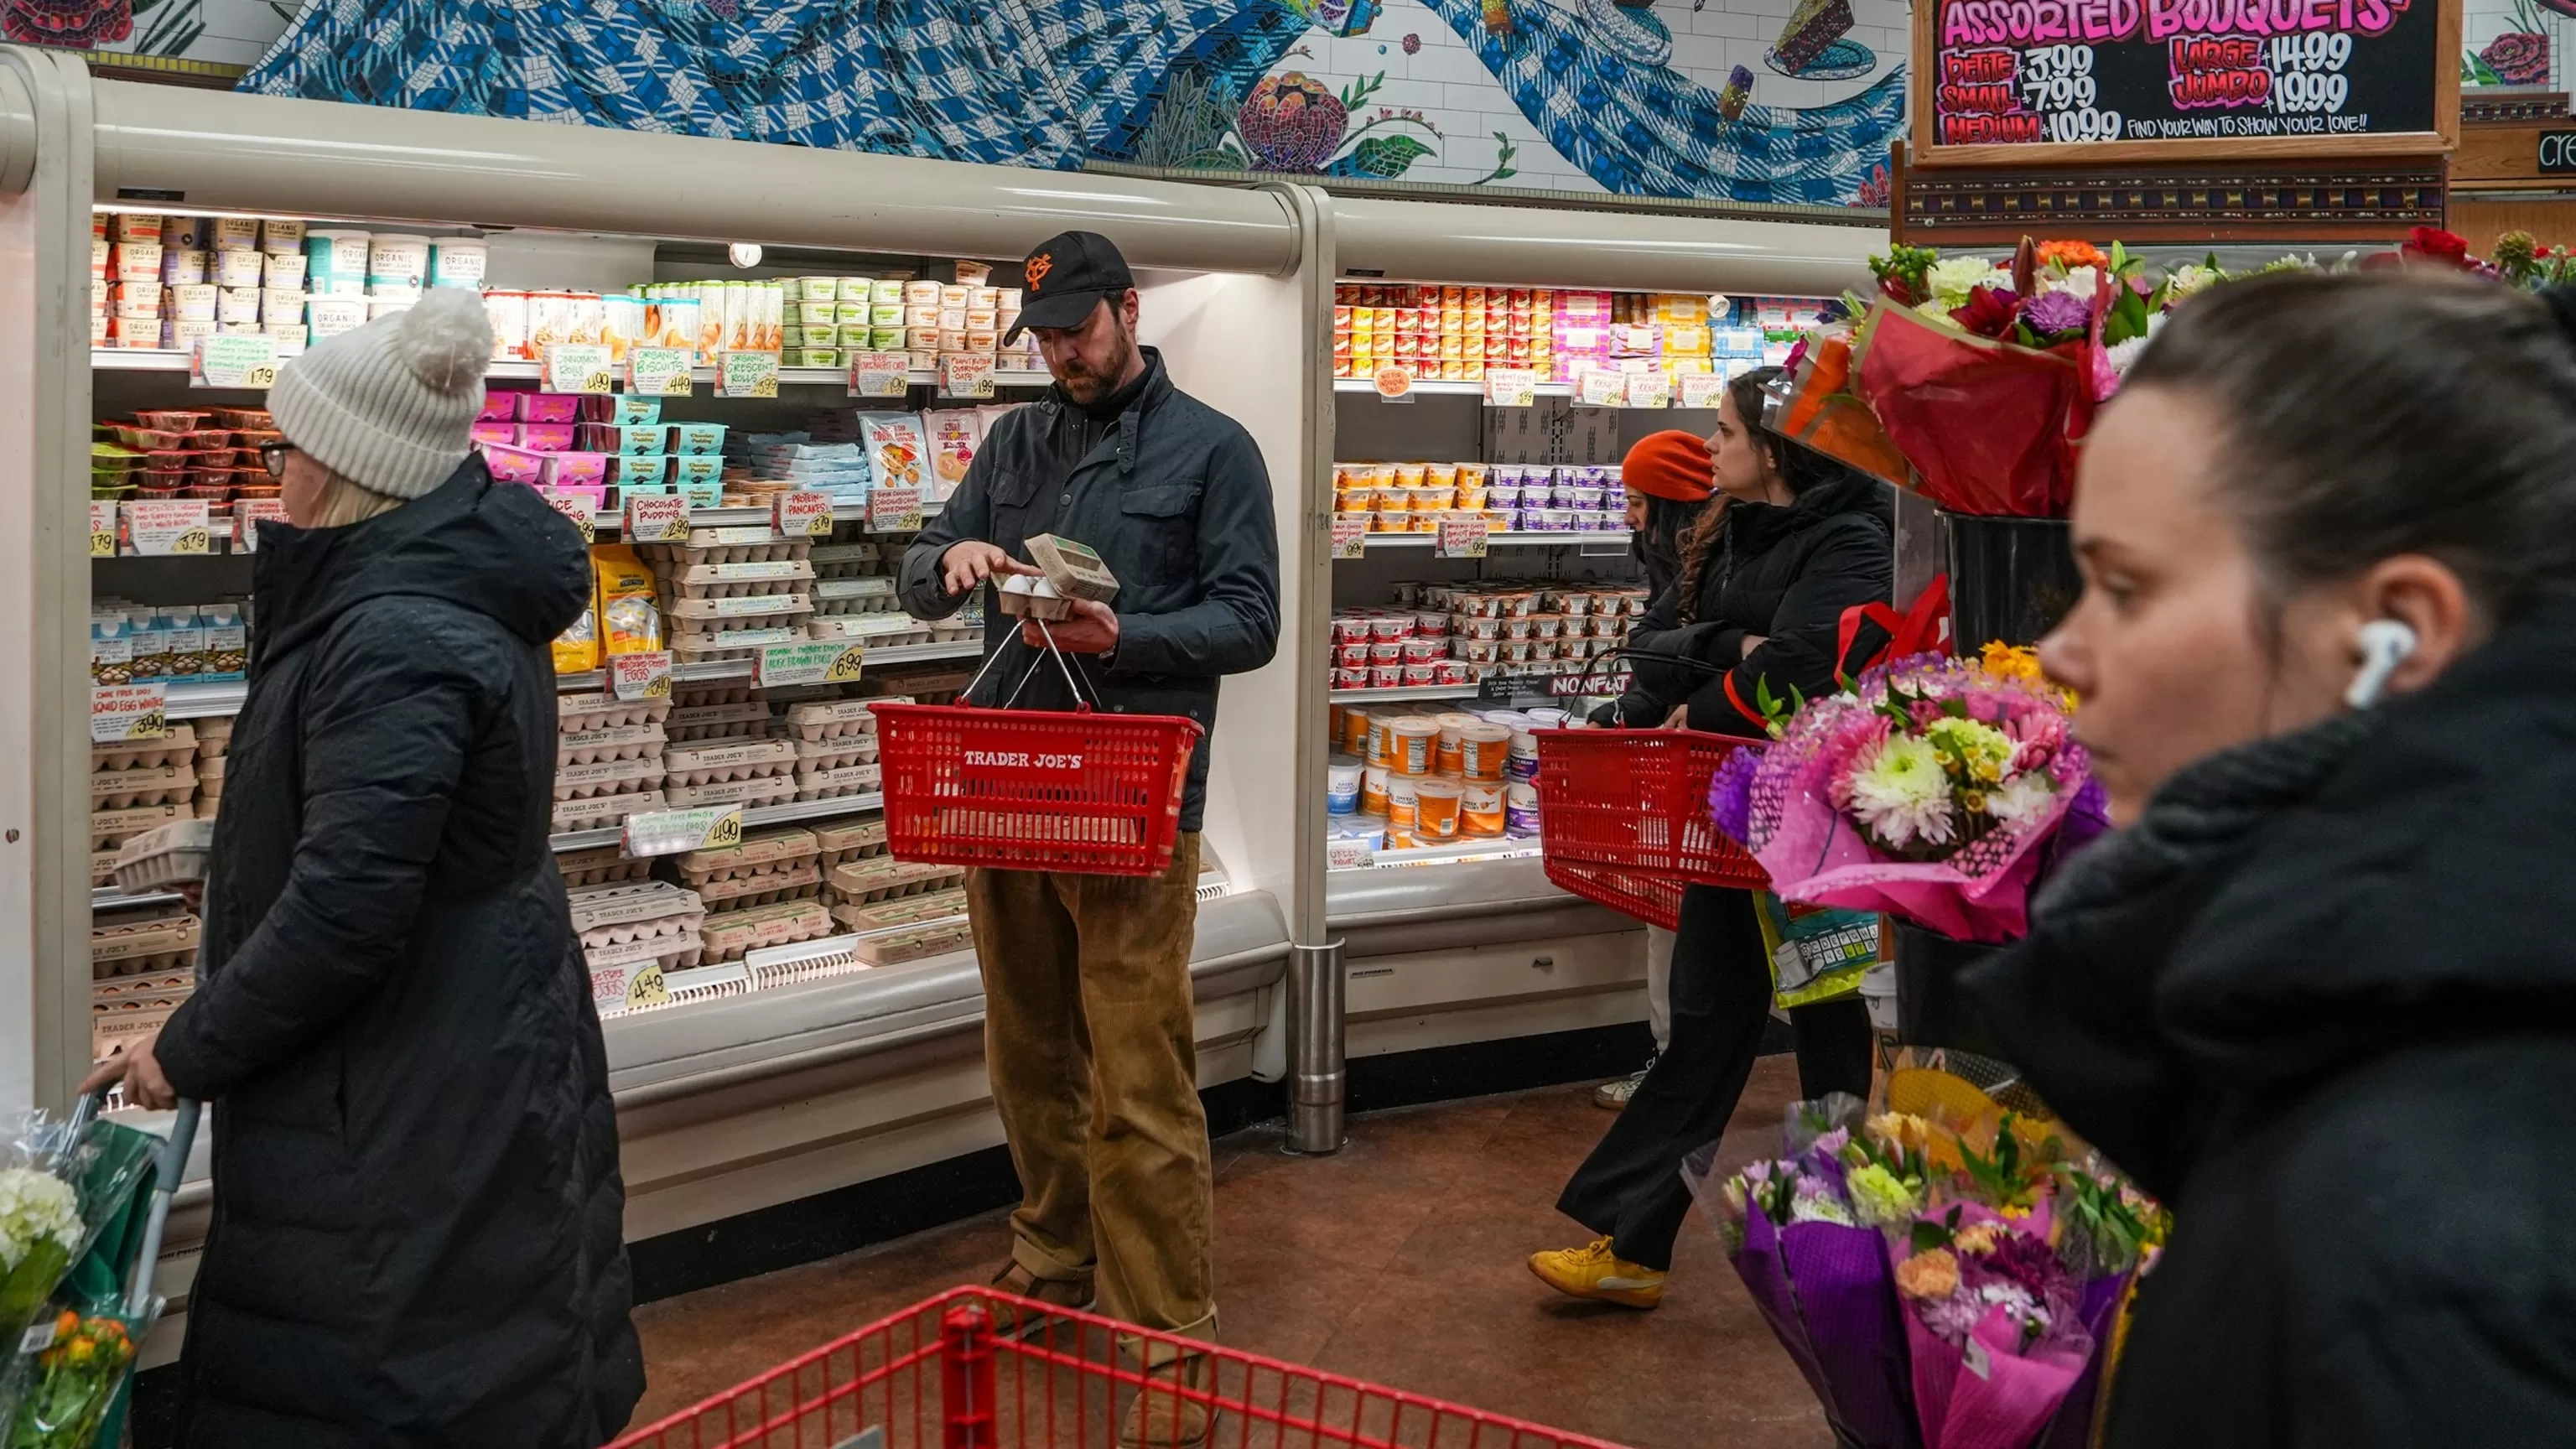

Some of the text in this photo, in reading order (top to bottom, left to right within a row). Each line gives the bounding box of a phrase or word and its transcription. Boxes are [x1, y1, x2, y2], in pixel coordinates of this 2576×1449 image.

[1944, 0, 2392, 46] ASSORTED BOUQUETS
[2172, 39, 2259, 73] LARGE
[1945, 52, 2014, 84] PETITE
[2174, 70, 2270, 102] JUMBO
[1941, 85, 2018, 113] SMALL
[1945, 114, 2040, 144] MEDIUM
[2127, 114, 2368, 140] FIND YOUR WAY TO SHOW YOUR LOVE!!
[375, 253, 413, 263] ORGANIC
[445, 257, 481, 265] ORGANIC
[318, 314, 356, 323] ORGANIC
[556, 354, 601, 365] CINNAMON
[637, 351, 681, 361] ORGANIC
[731, 354, 765, 362] ORGANIC
[951, 357, 993, 366] PEANUT BUTTER
[559, 366, 584, 377] ROLLS
[726, 362, 775, 373] CRESCENT
[952, 365, 989, 373] OVERNIGHT
[251, 368, 273, 384] 1.79
[731, 374, 757, 384] ROLLS
[954, 373, 973, 382] OATS
[792, 493, 820, 503] PROTEIN
[636, 498, 683, 511] CHOCOLATE
[788, 504, 826, 516] PANCAKES
[896, 504, 914, 512] DOUGH
[640, 509, 680, 522] PUDDING
[667, 520, 689, 538] 2.99
[179, 532, 205, 551] 3.79
[1447, 538, 1472, 547] YOGURT
[766, 647, 793, 657] ORGANIC
[766, 654, 832, 671] LARGE BROWN EGGS
[836, 652, 862, 677] 6.99
[624, 668, 650, 683] EGGS
[119, 699, 137, 712] EGG
[138, 697, 164, 709] WHITES
[578, 698, 601, 706] TRADER
[565, 732, 610, 743] TRADER JOE'S
[964, 750, 1083, 770] TRADER JOE'S
[566, 767, 610, 778] TRADER JOE'S
[96, 778, 122, 787] JOE'S
[562, 804, 587, 813] TRADER
[97, 817, 122, 825] JOE'S
[685, 820, 708, 833] EGGS
[1330, 848, 1361, 859] GREEK
[1332, 858, 1357, 866] YOGURT
[599, 906, 645, 918] TRADER JOE'S
[106, 944, 127, 954] JOE'S
[599, 943, 644, 957] TRADER JOE'S
[604, 969, 625, 980] FREE
[592, 979, 626, 999] EGGS
[634, 974, 663, 1000] 4.49
[102, 1020, 163, 1033] TRADER JOE'S
